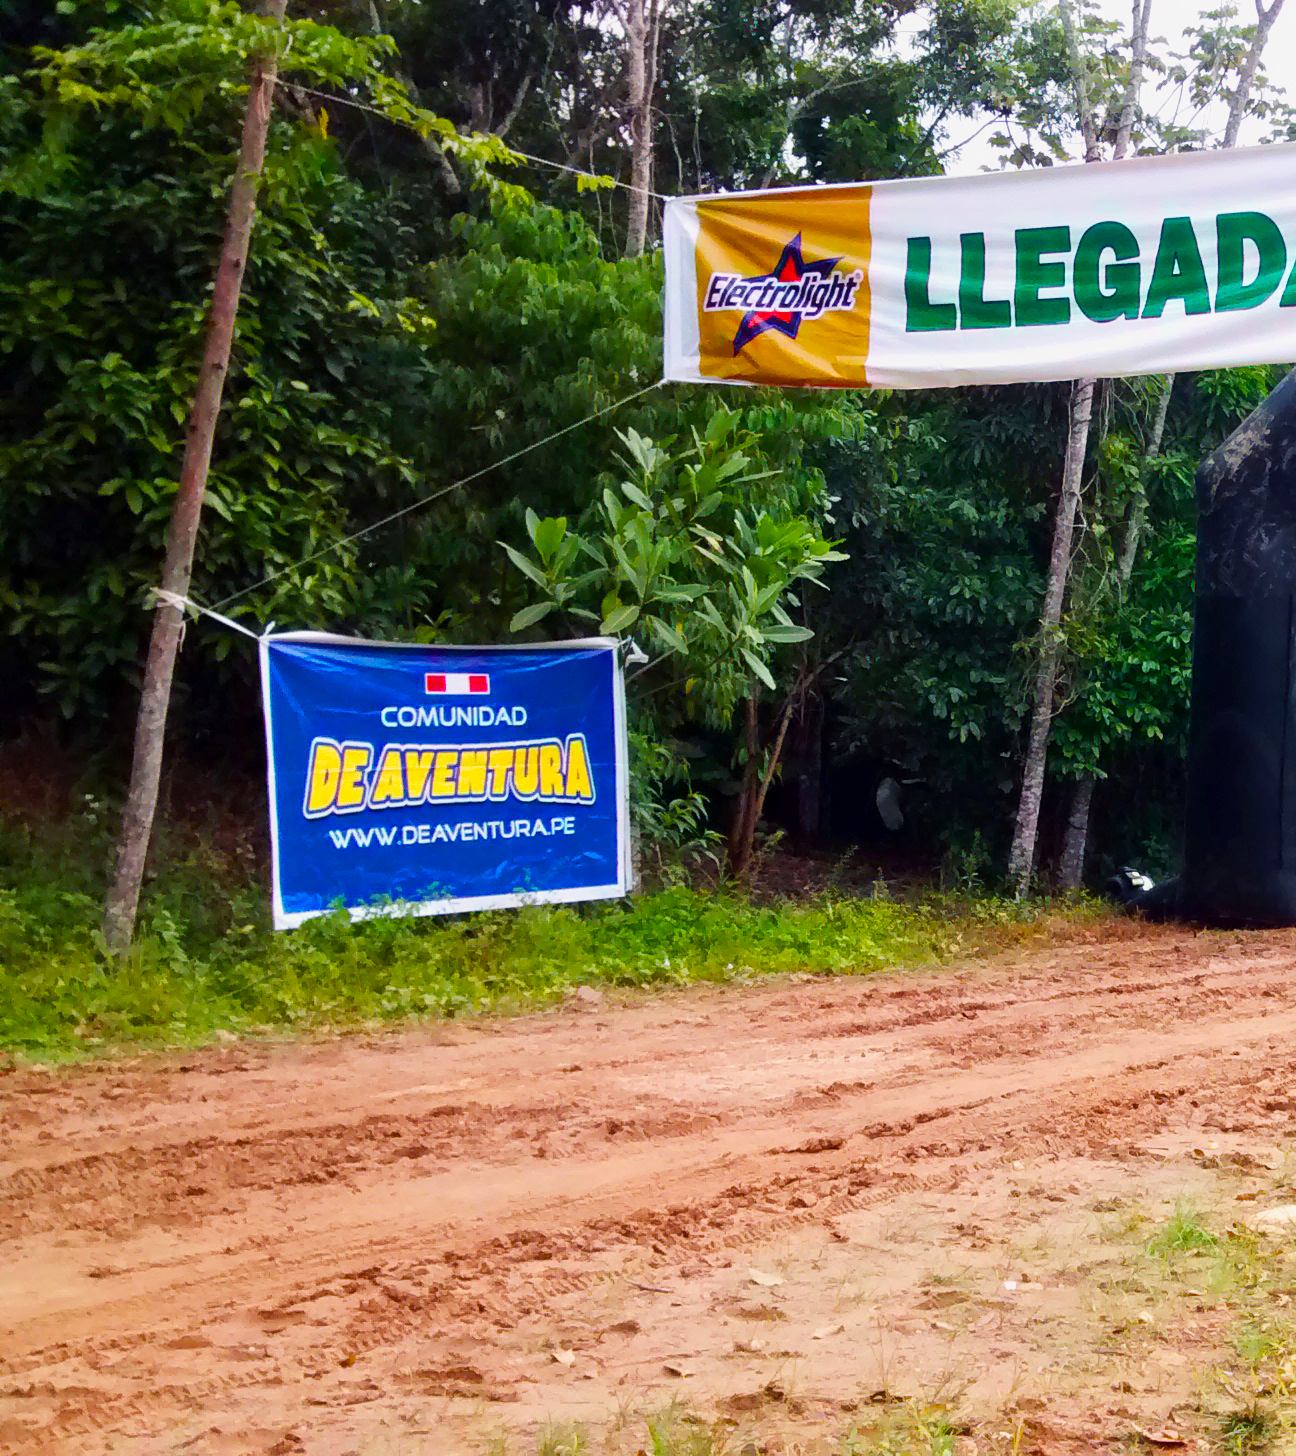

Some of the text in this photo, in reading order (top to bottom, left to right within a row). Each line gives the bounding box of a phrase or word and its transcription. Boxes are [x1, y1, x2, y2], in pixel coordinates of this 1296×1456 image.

[704, 272, 858, 317] Electrolight
[380, 706, 527, 728] COMUNIDAD
[305, 737, 594, 815] DE AVENTURA
[329, 817, 575, 849] WWW.DEAVENTURA.PE
